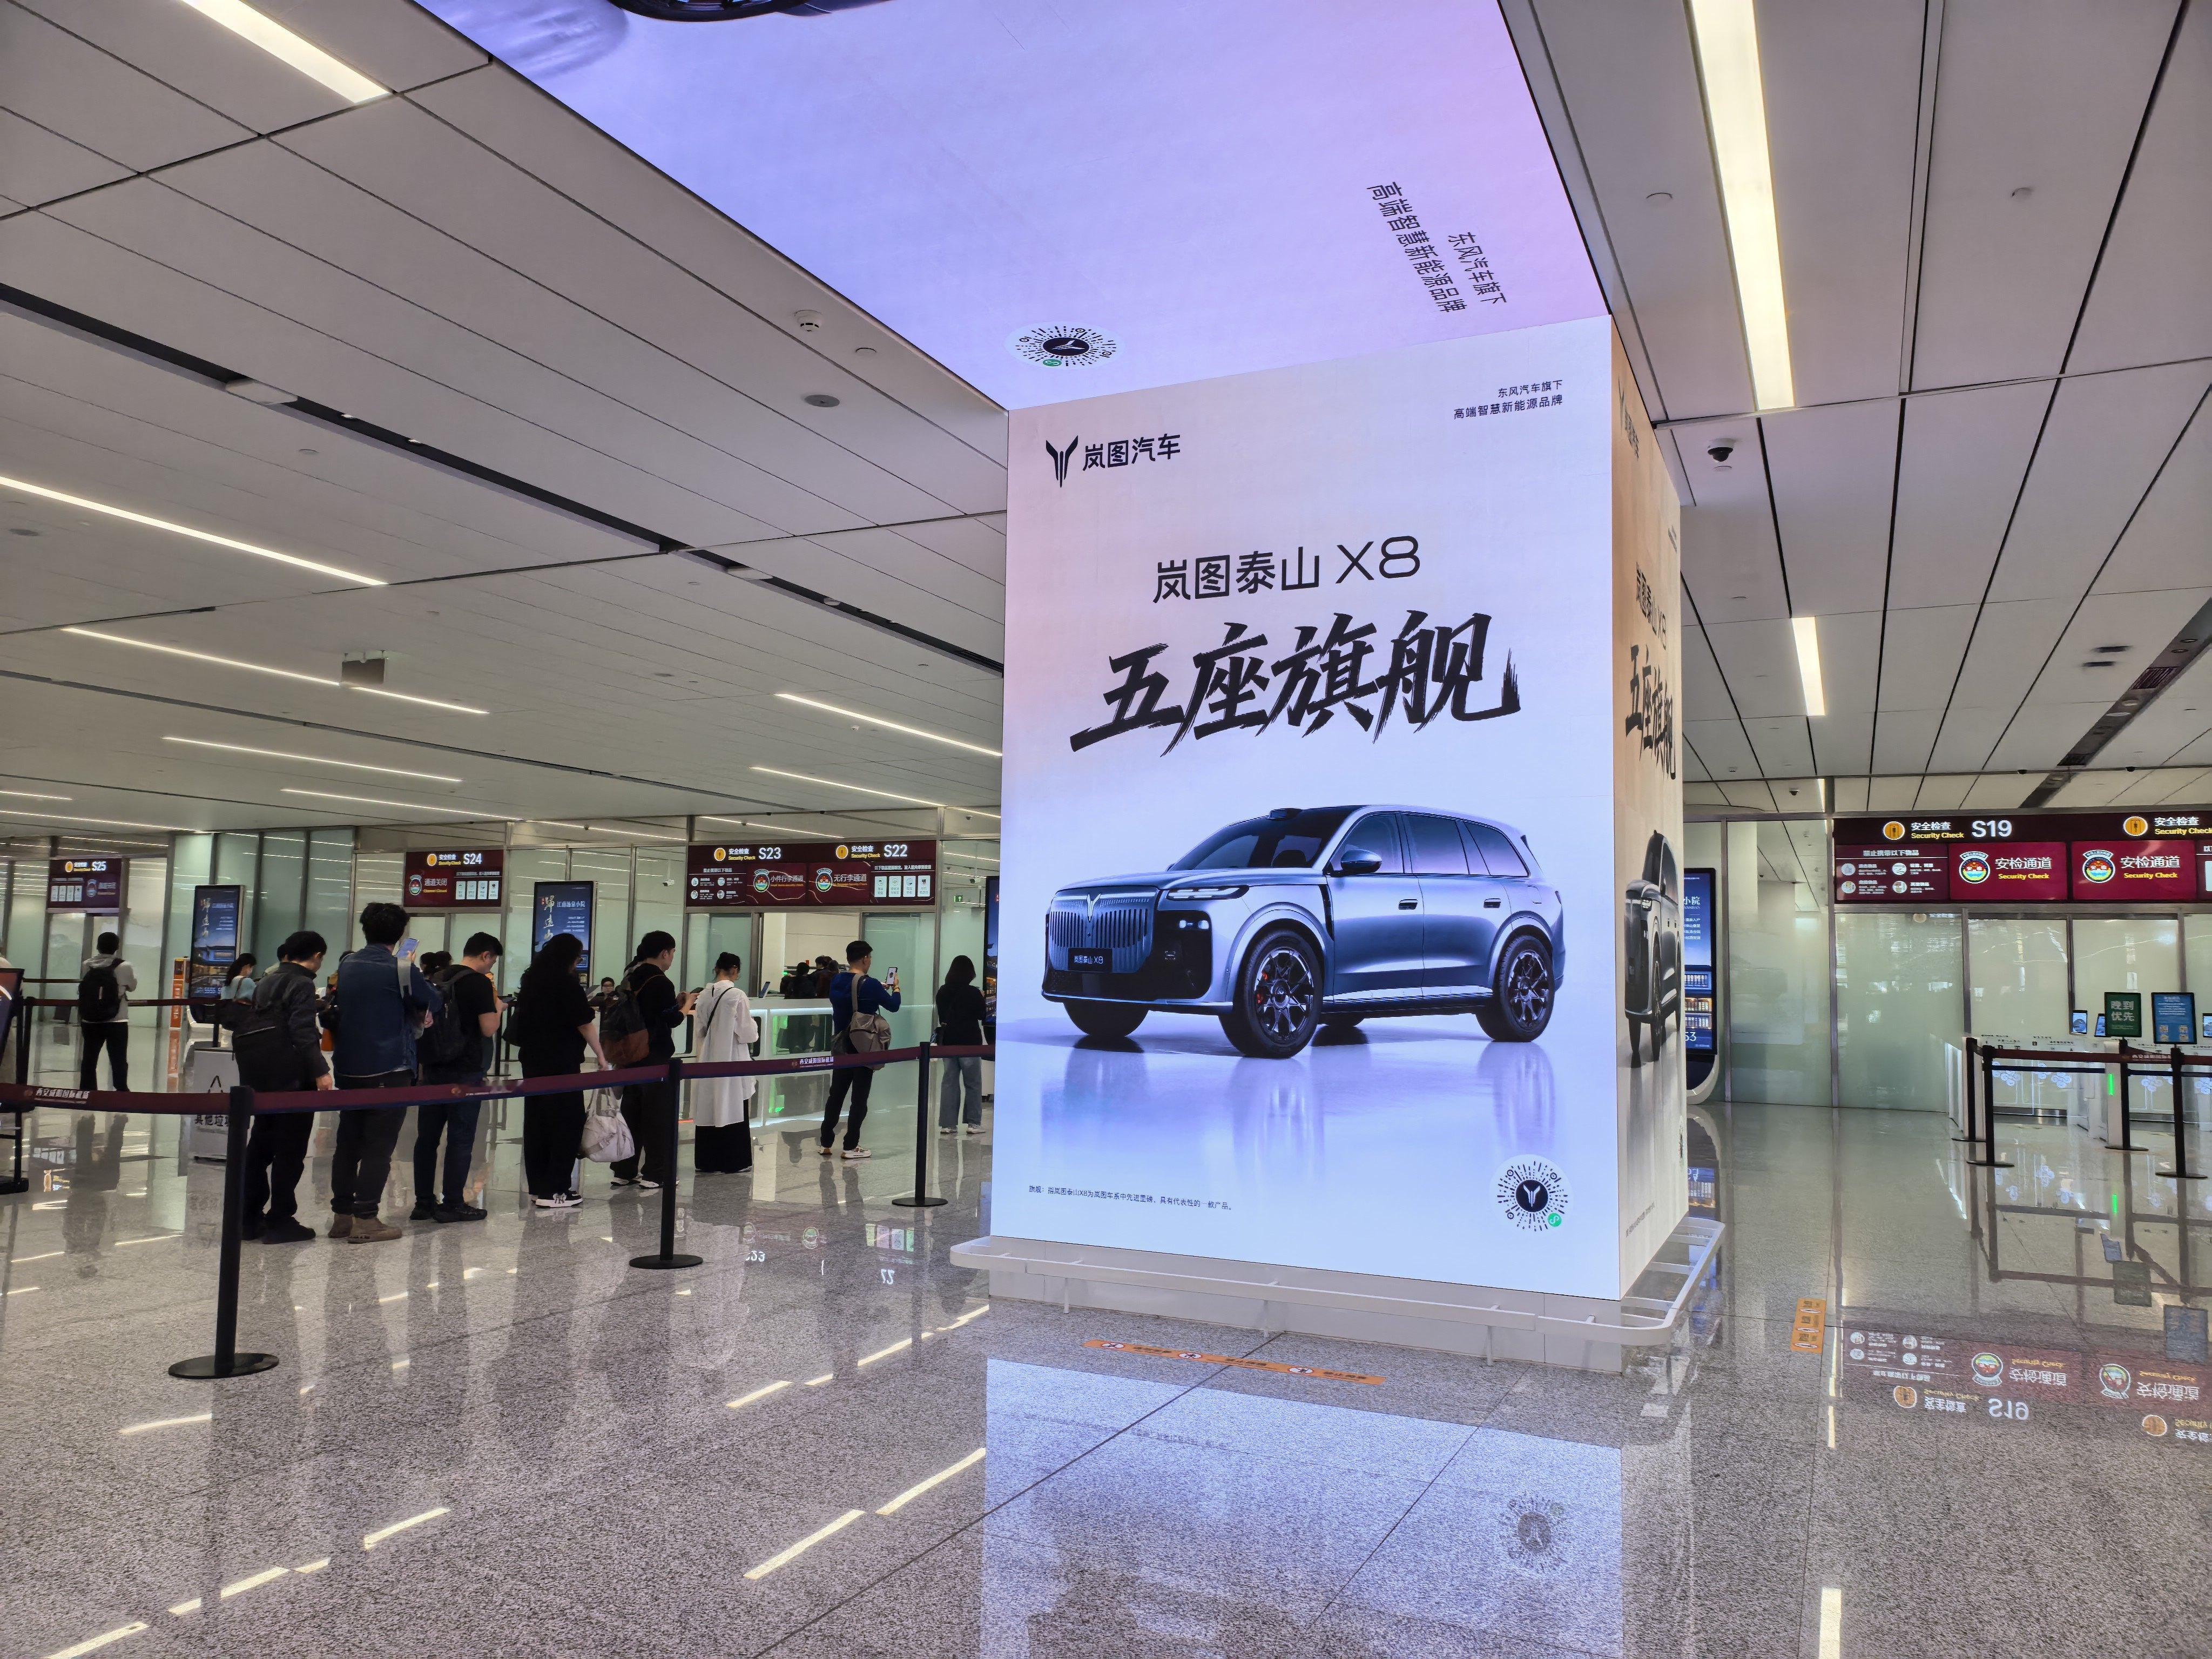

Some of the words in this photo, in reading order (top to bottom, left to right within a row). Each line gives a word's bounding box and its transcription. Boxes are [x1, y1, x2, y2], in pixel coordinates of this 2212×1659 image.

[1366, 181, 1467, 313] 高端智慧新能源品牌
[1447, 232, 1507, 304] 东风汽车旗下
[1498, 380, 1563, 398] 东风汽车旗下
[1454, 394, 1563, 420] 高端智慧新能源品牌
[1082, 433, 1181, 471] 岚图汽车
[1153, 545, 1320, 603] 岚图泰山
[1336, 535, 1421, 584] X8
[1070, 610, 1521, 757] 五座旗舰
[1911, 821, 1951, 831] 安全检查
[2154, 817, 2199, 826] 安全检查
[1972, 820, 2012, 838] S19
[758, 847, 781, 860] S23
[884, 844, 908, 858] S22
[91, 861, 107, 871] S25
[463, 853, 483, 865] S24
[1995, 857, 2052, 869] 安检通道
[2120, 855, 2181, 869] 安检通道
[833, 874, 867, 882] 无行李通道
[2111, 1011, 2135, 1021] 优先
